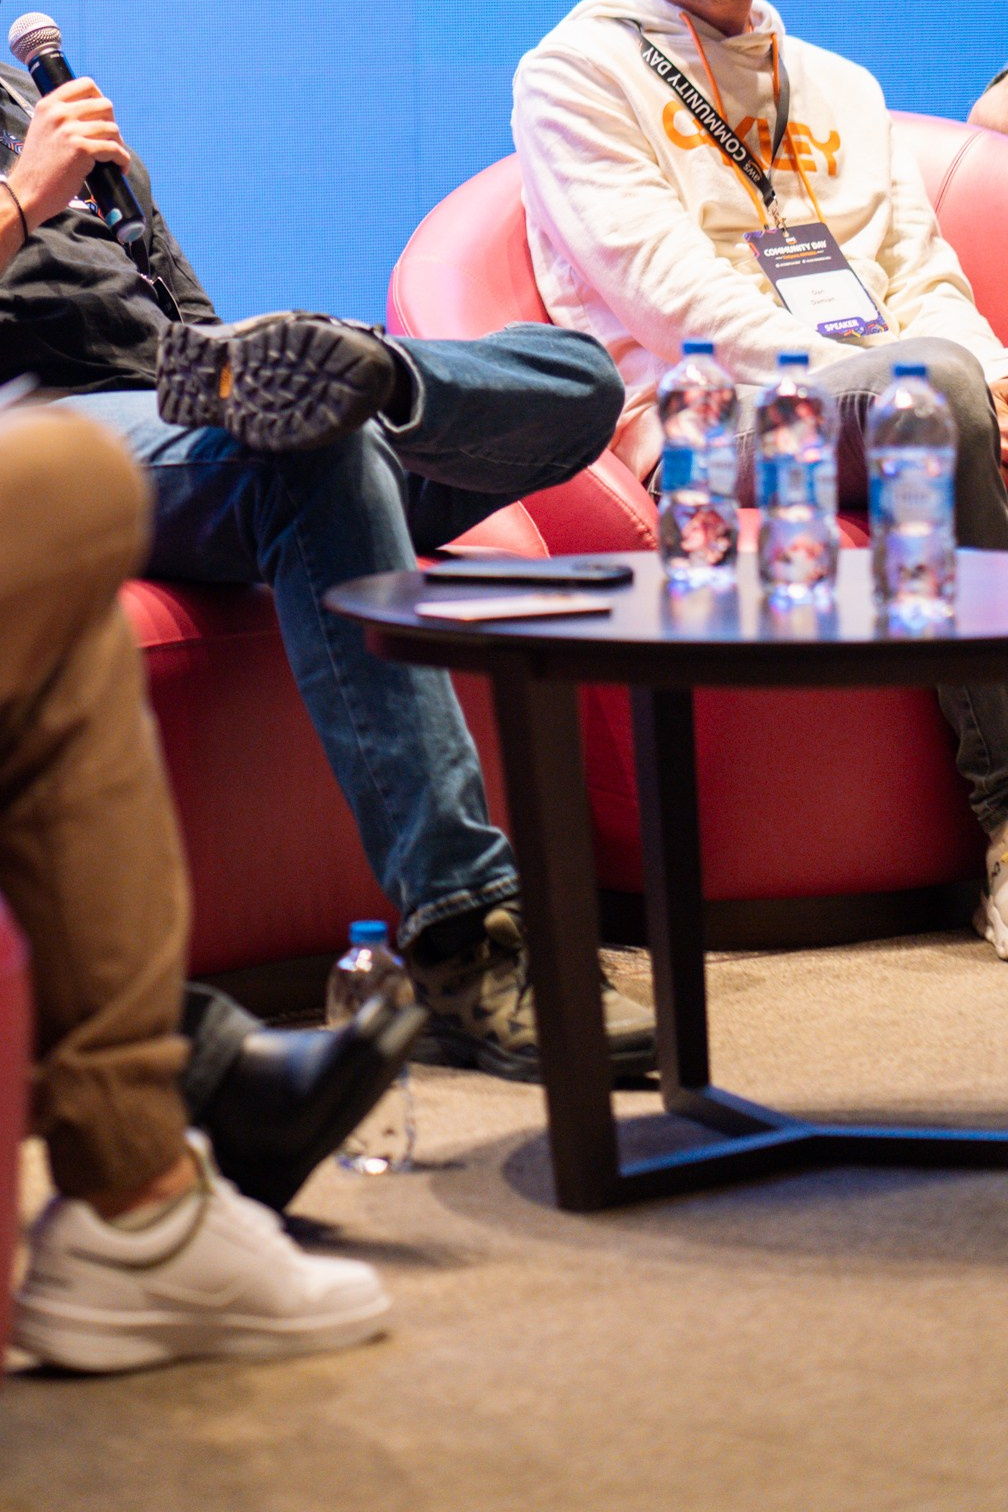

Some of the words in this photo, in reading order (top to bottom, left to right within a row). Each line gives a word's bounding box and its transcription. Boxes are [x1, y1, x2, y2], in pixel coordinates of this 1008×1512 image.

[642, 46, 673, 76] DAY
[666, 73, 747, 162] COMMUNITY
[662, 100, 841, 177] OLEY
[742, 162, 761, 182] aws
[764, 243, 811, 257] COMMUNITY
[824, 320, 859, 331] SPEAKER
